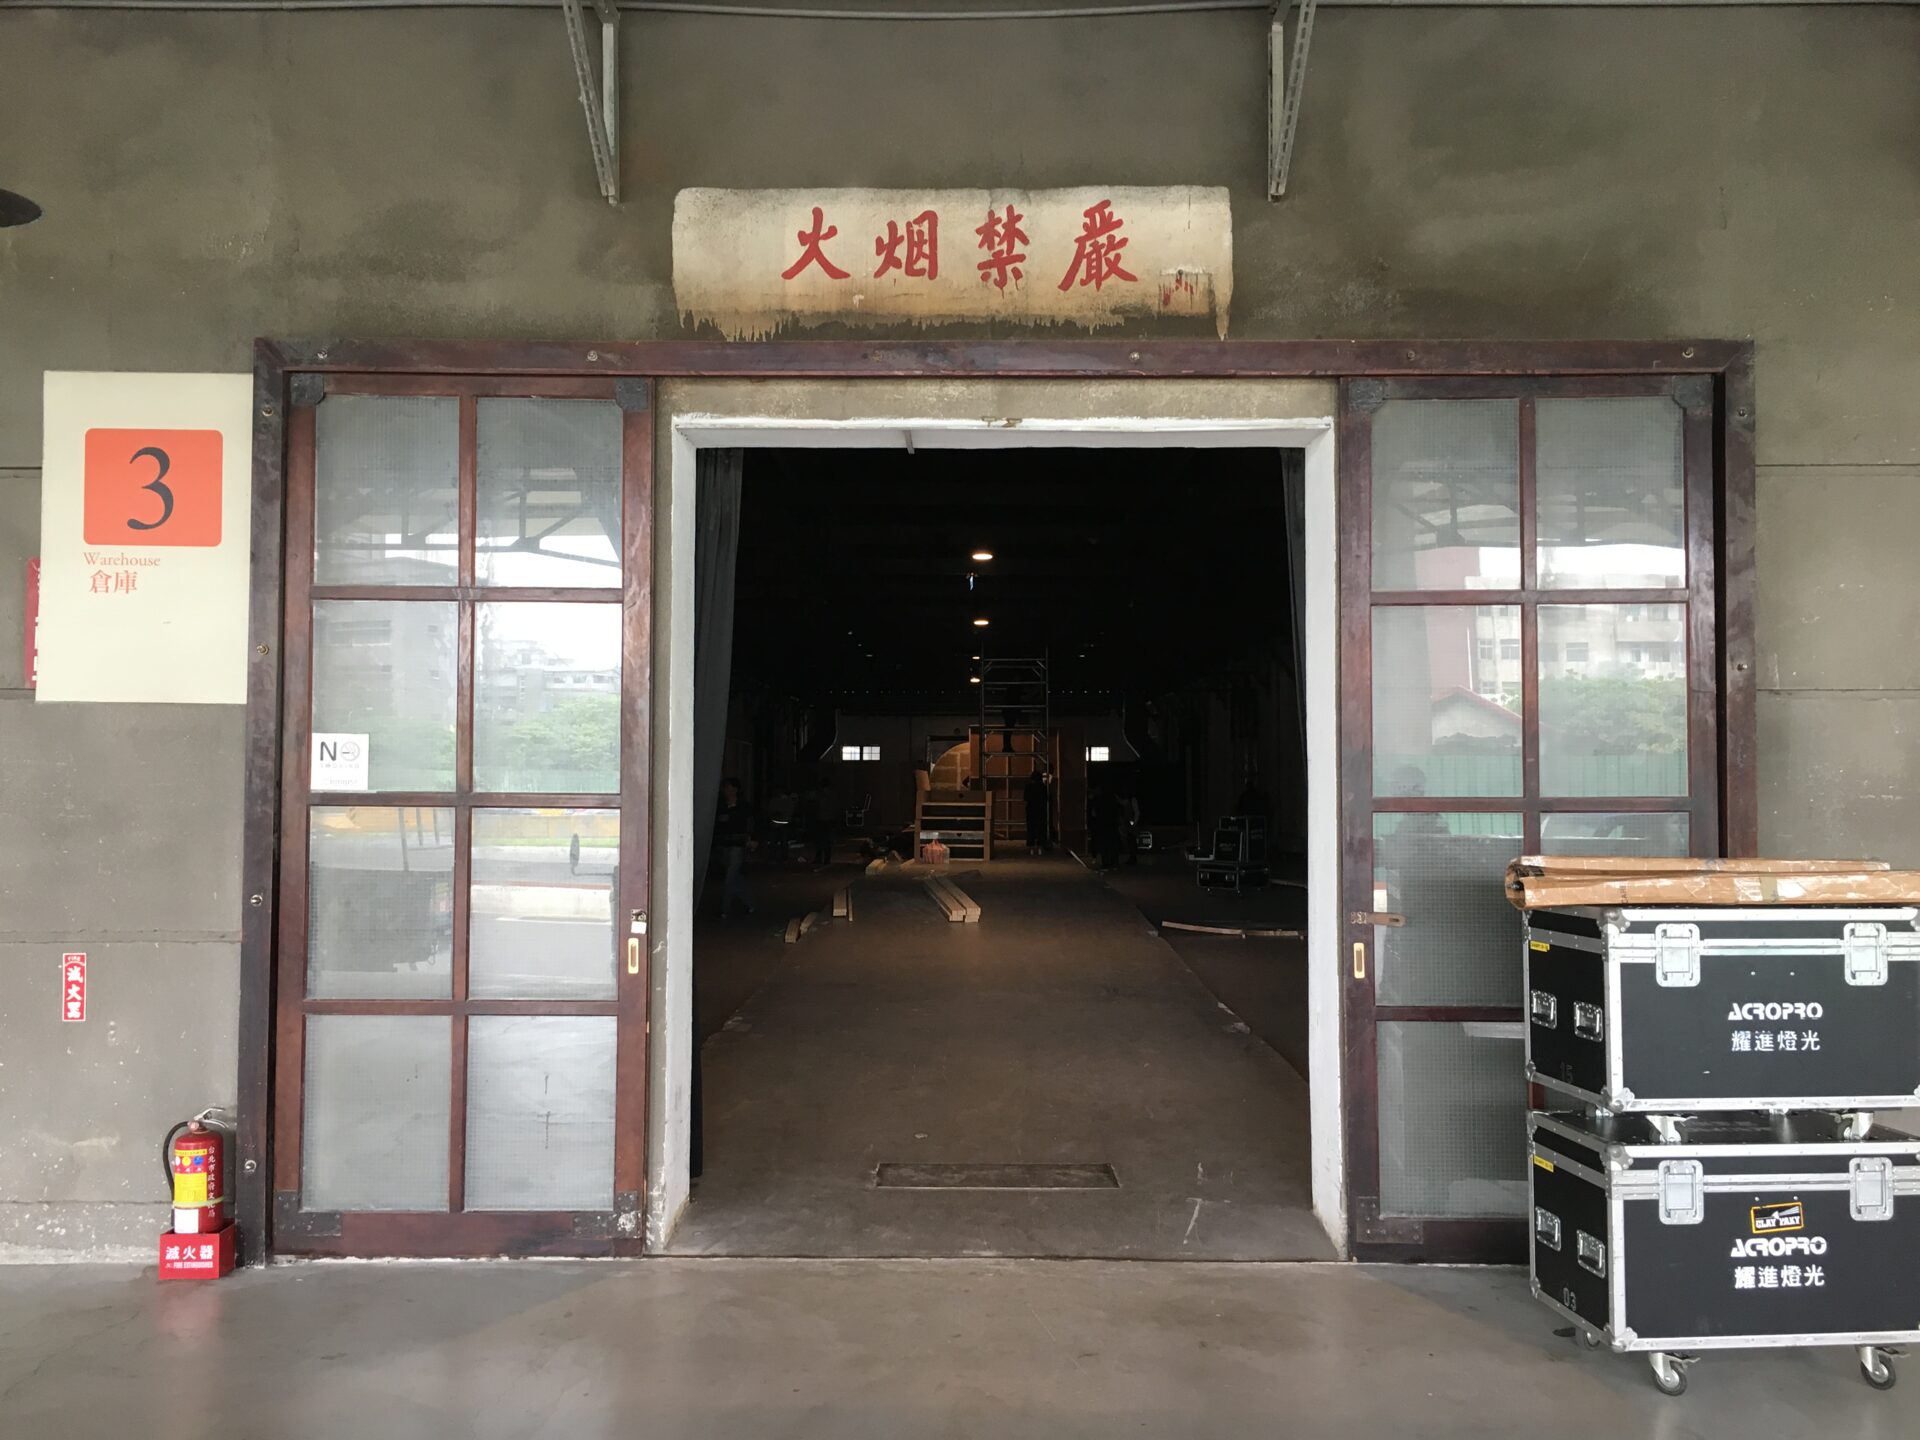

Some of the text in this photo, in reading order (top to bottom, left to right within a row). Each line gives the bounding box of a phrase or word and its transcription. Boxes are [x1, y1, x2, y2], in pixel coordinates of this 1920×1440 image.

[127, 446, 174, 530] 3
[83, 552, 160, 566] Warehouse
[89, 569, 137, 593] 倉庫
[1727, 1002, 1823, 1020] ACROPRO
[1731, 1030, 1820, 1051] 耀進燈光
[165, 1245, 213, 1260] 滅火器
[1730, 1236, 1827, 1257] ACROPRO
[1734, 1264, 1825, 1289] 耀進燈光
